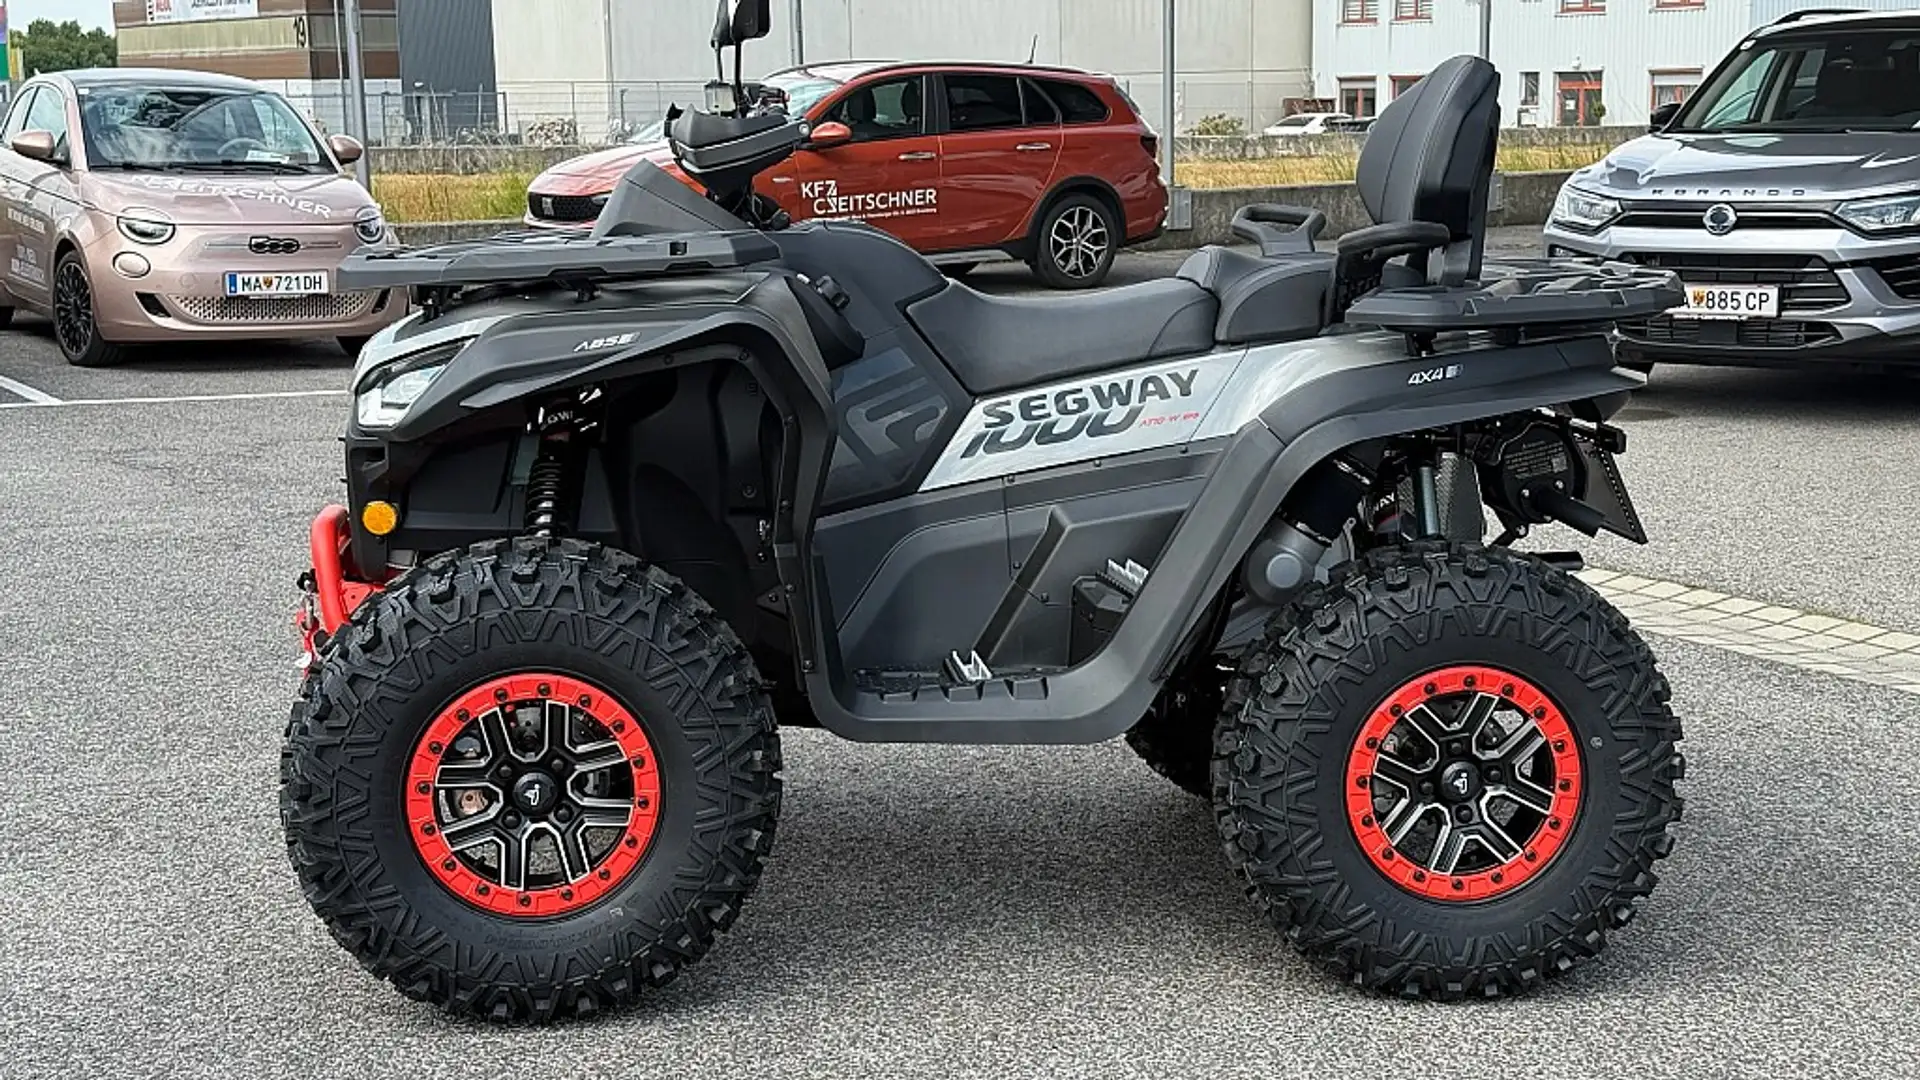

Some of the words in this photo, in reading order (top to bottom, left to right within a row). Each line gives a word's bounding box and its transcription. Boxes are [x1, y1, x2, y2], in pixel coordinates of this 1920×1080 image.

[801, 180, 838, 199] KFZ
[241, 276, 263, 292] MA
[982, 368, 1199, 430] SEGWAY
